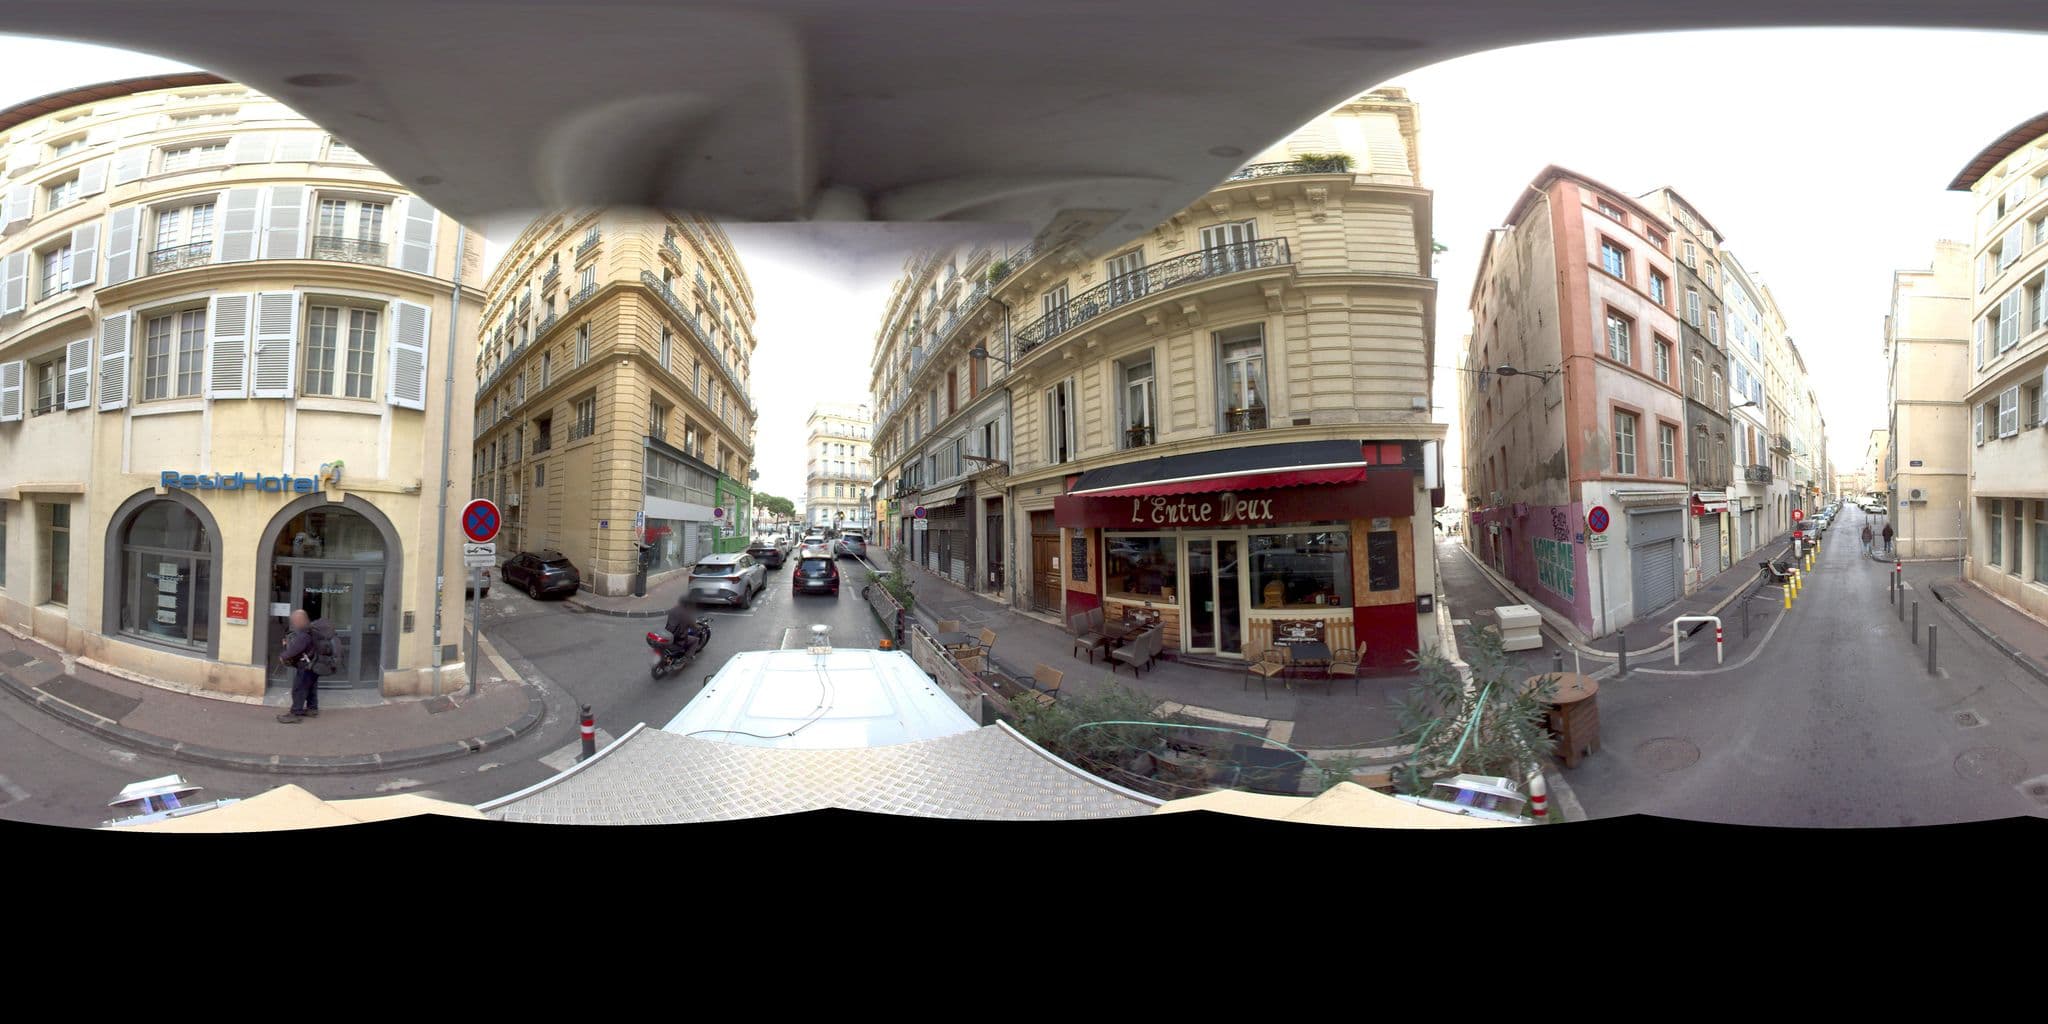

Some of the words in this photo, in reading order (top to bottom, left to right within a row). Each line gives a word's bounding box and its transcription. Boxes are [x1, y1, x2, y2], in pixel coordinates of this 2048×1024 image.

[161, 471, 319, 493] ResidHotel
[1132, 496, 1212, 523] L'Entre
[1221, 492, 1273, 522] Deux
